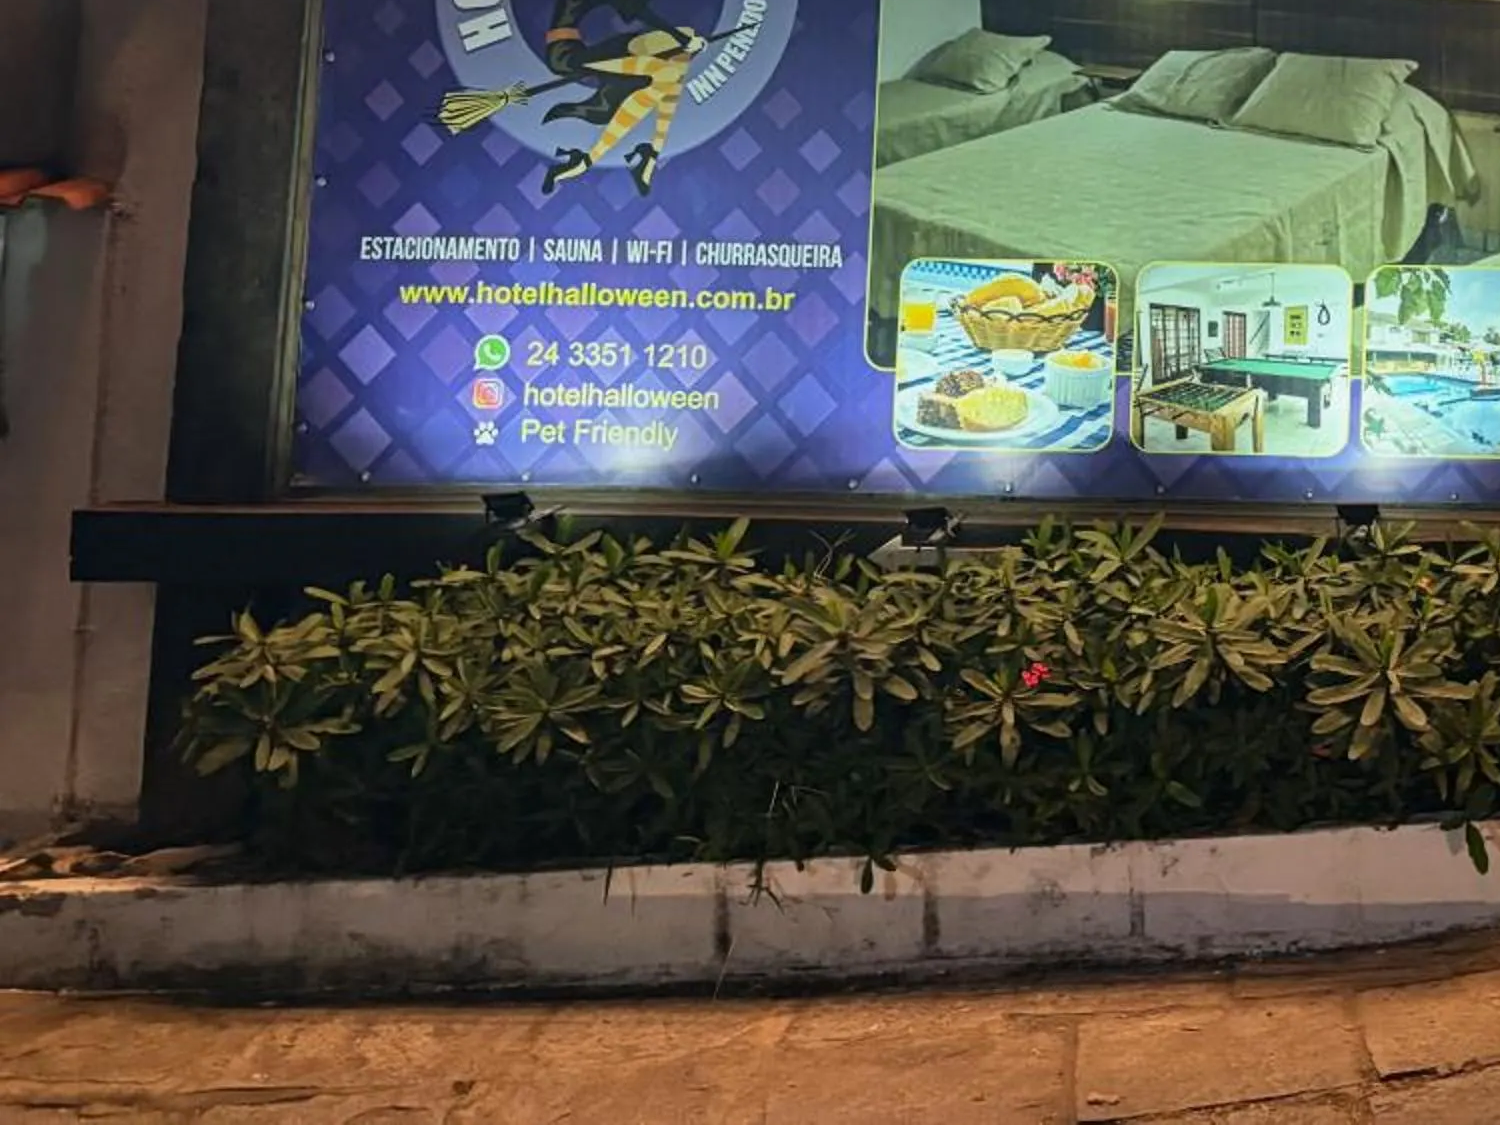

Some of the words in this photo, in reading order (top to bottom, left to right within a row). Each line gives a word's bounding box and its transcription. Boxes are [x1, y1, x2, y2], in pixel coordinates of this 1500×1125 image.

[686, 63, 728, 104] INN
[359, 236, 520, 261] ESTACIONAMENTO
[542, 238, 603, 263] SAUNA
[627, 240, 673, 264] WI-FI
[695, 242, 843, 268] CHURRASQUEIRA
[399, 281, 796, 311] www.hotelhalloween.com.br
[526, 341, 560, 366] 24
[568, 342, 631, 368] 3351
[643, 344, 708, 370] 1210
[522, 382, 720, 410] hotelhalloween
[520, 418, 566, 444] Pet
[573, 420, 679, 452] Friendly
